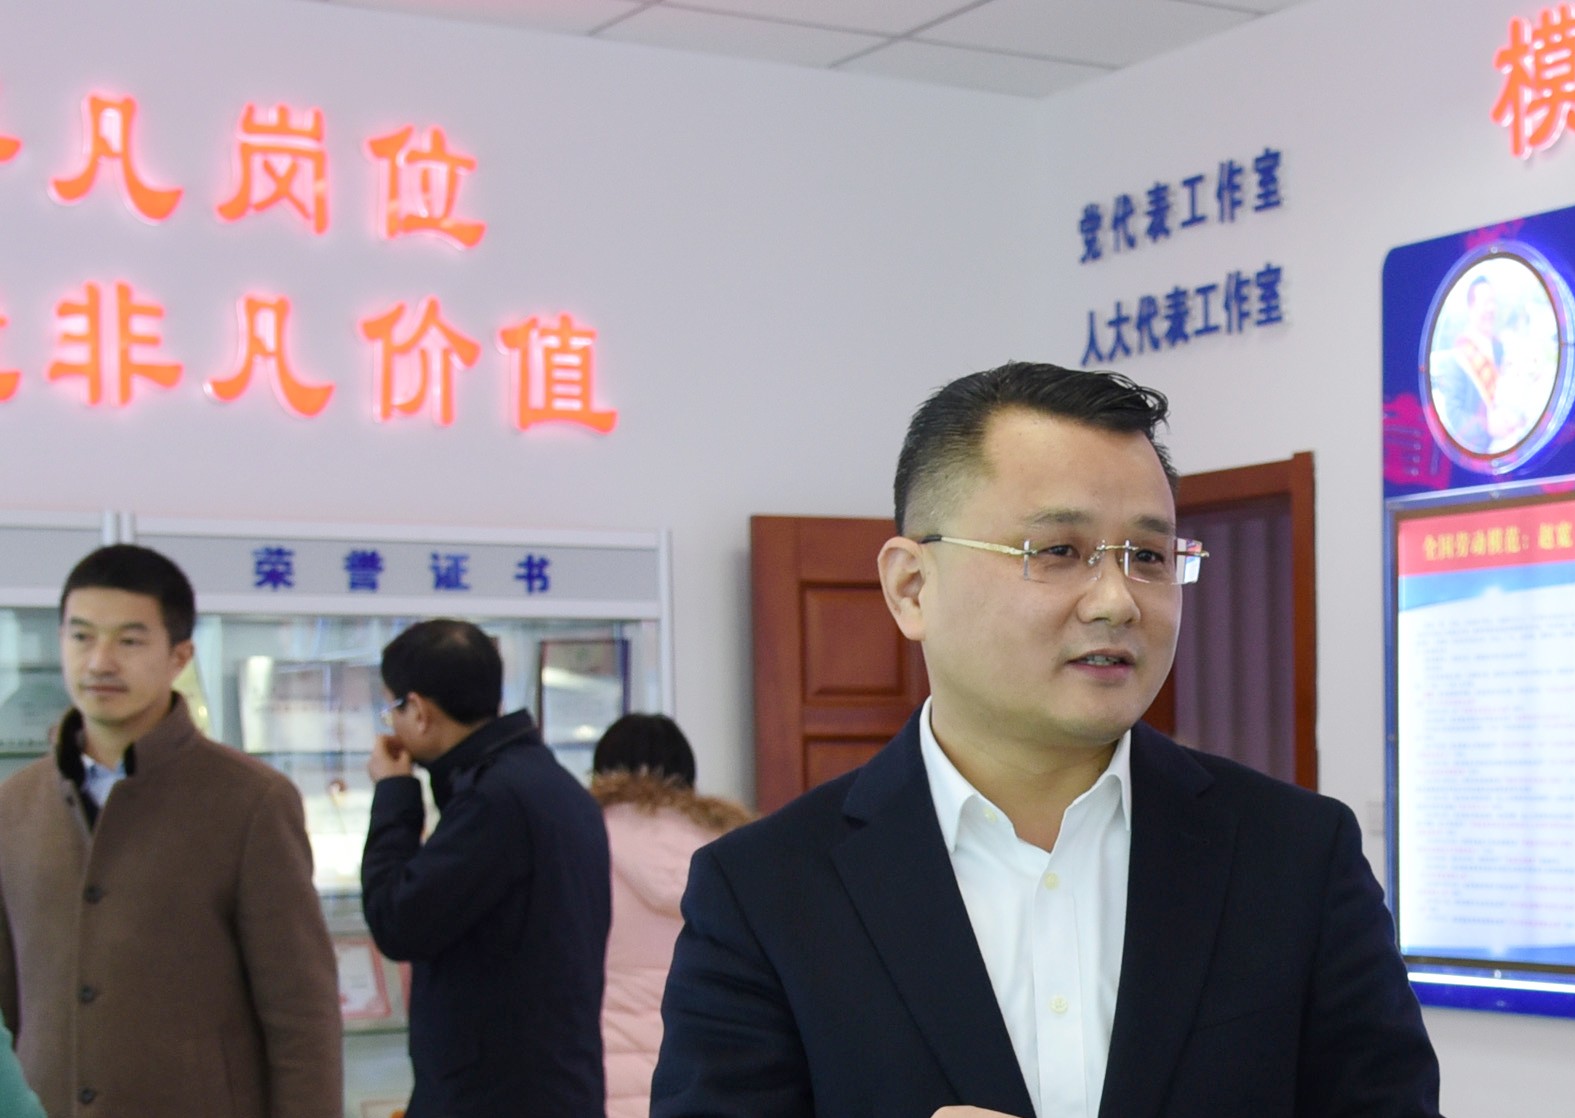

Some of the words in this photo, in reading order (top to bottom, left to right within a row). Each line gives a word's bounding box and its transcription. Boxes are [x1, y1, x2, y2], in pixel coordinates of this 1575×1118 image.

[0, 95, 487, 250] 凡岗位
[1079, 148, 1283, 264] 党代表工作室
[0, 281, 618, 433] 非凡价值
[1081, 263, 1283, 366] 人大代表工作室
[252, 546, 552, 595] 荣誉证书
